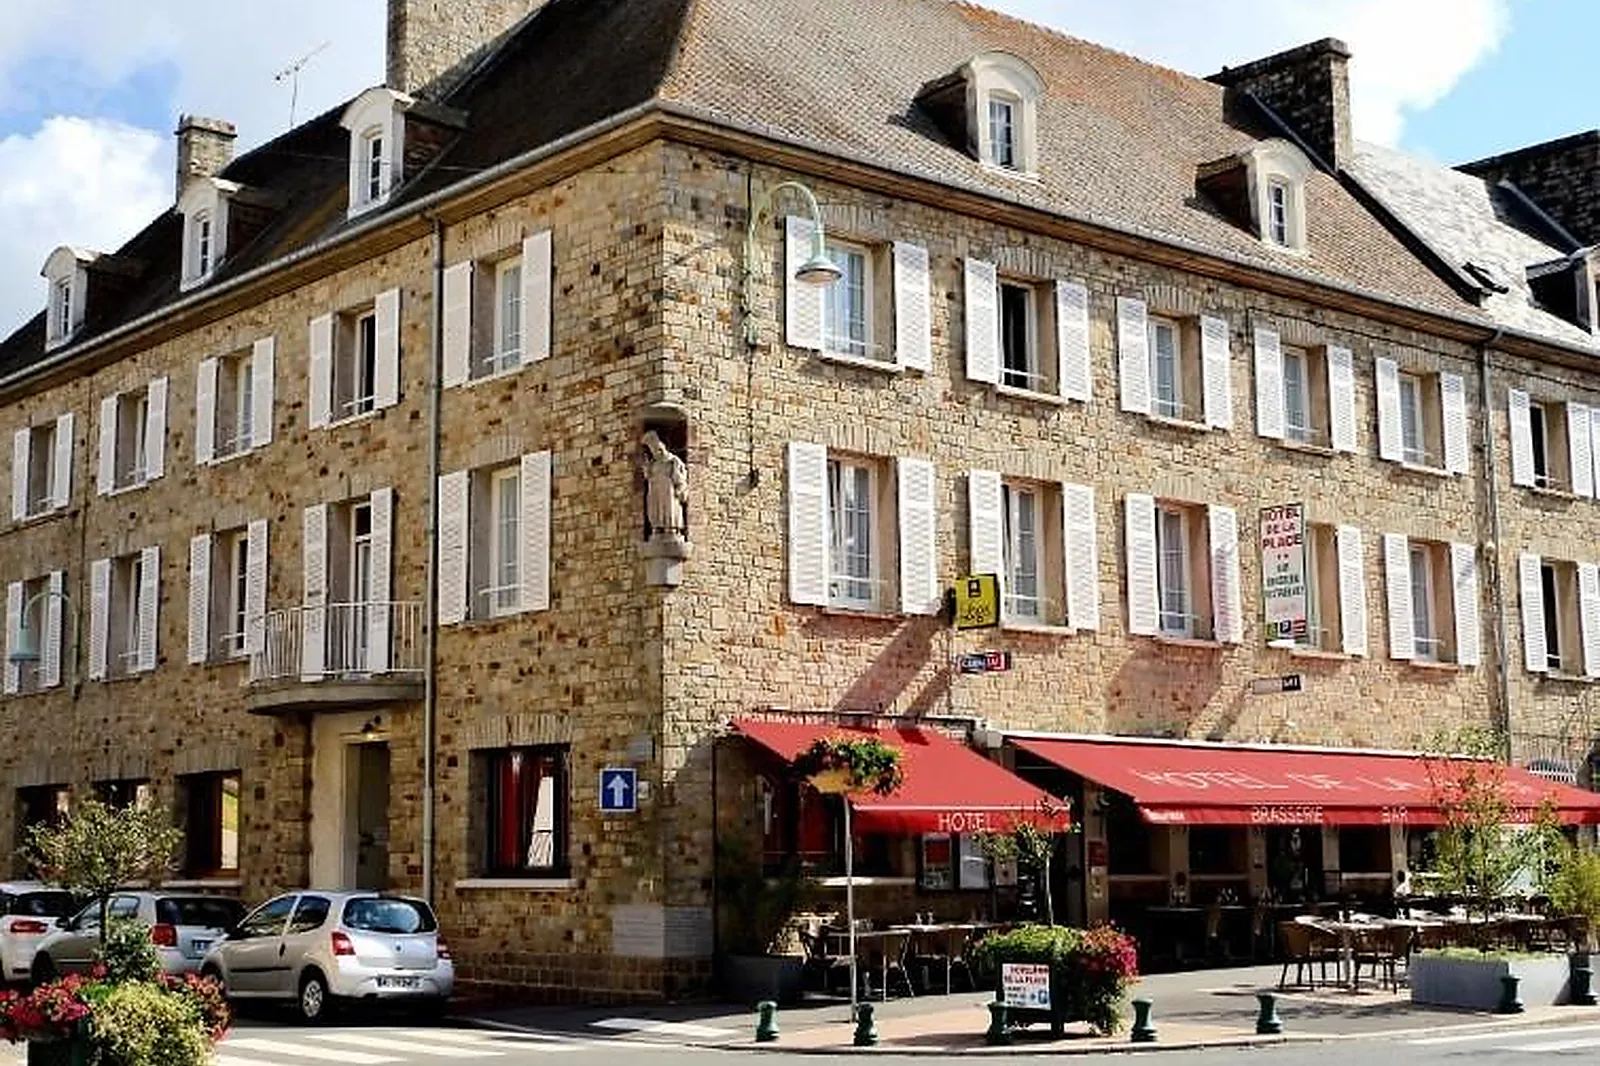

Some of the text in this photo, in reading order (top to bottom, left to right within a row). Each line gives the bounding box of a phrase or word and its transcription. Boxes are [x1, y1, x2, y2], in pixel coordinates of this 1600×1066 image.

[1262, 533, 1303, 549] PLACE
[938, 812, 997, 832] HOTEL
[1251, 805, 1323, 823] BRASSERIE
[1382, 806, 1408, 823] BAR
